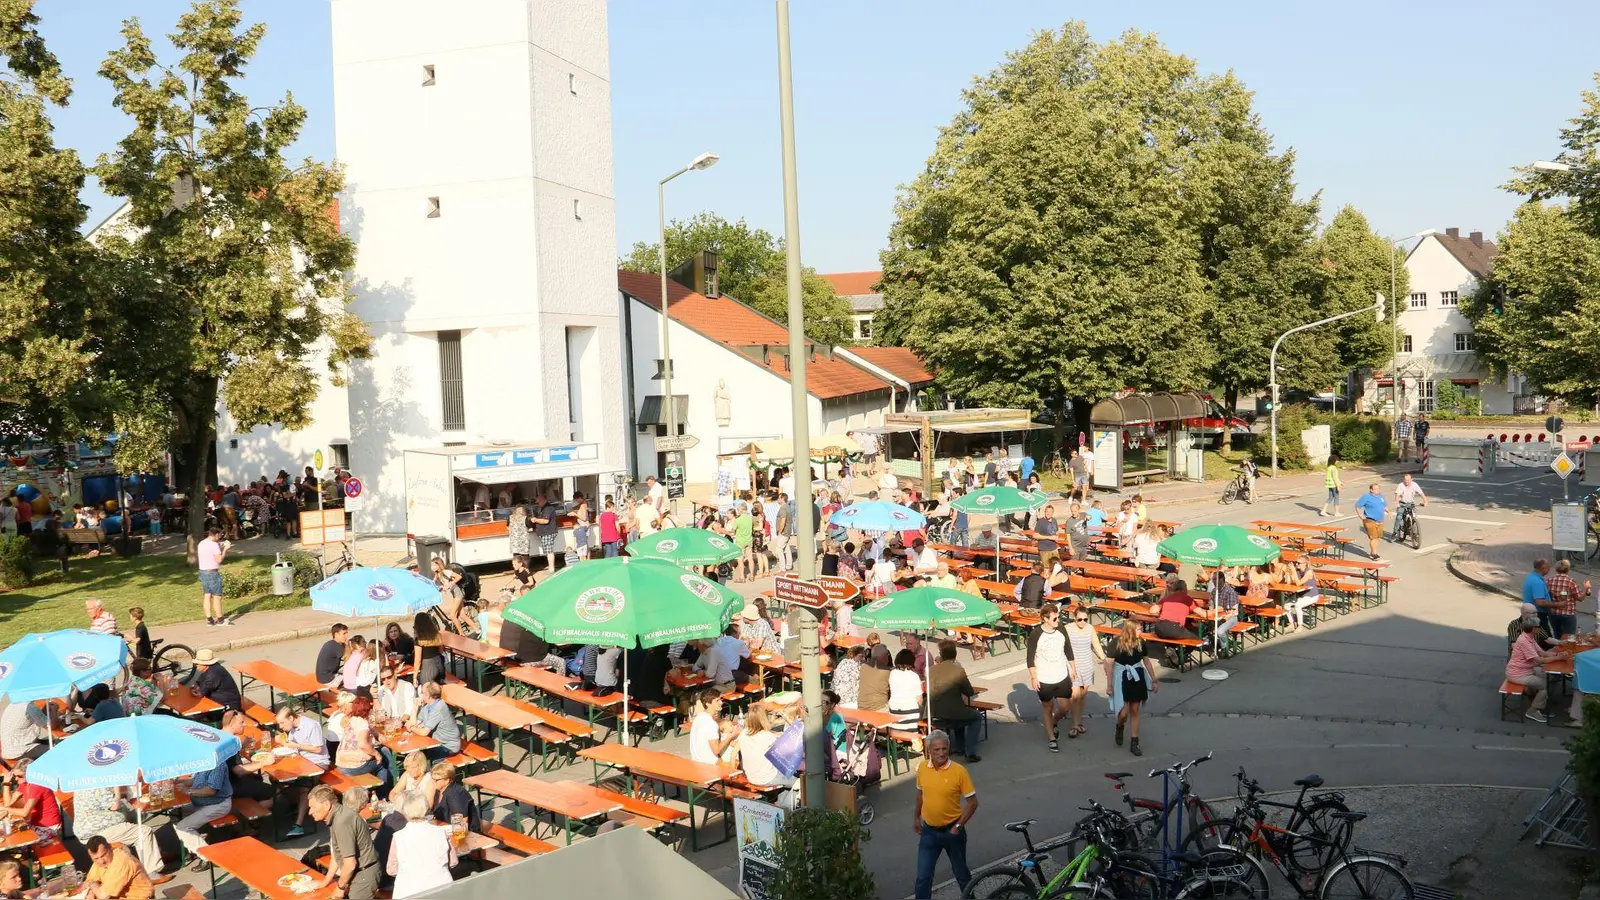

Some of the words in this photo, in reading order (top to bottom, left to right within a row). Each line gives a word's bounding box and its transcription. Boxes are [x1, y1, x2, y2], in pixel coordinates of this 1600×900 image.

[776, 581, 792, 591] SPORT
[552, 629, 600, 637] HOFBRAUHAUS
[601, 631, 629, 640] FREISING
[643, 627, 686, 640] HOFBRAUHAUS
[686, 623, 712, 633] FREISING
